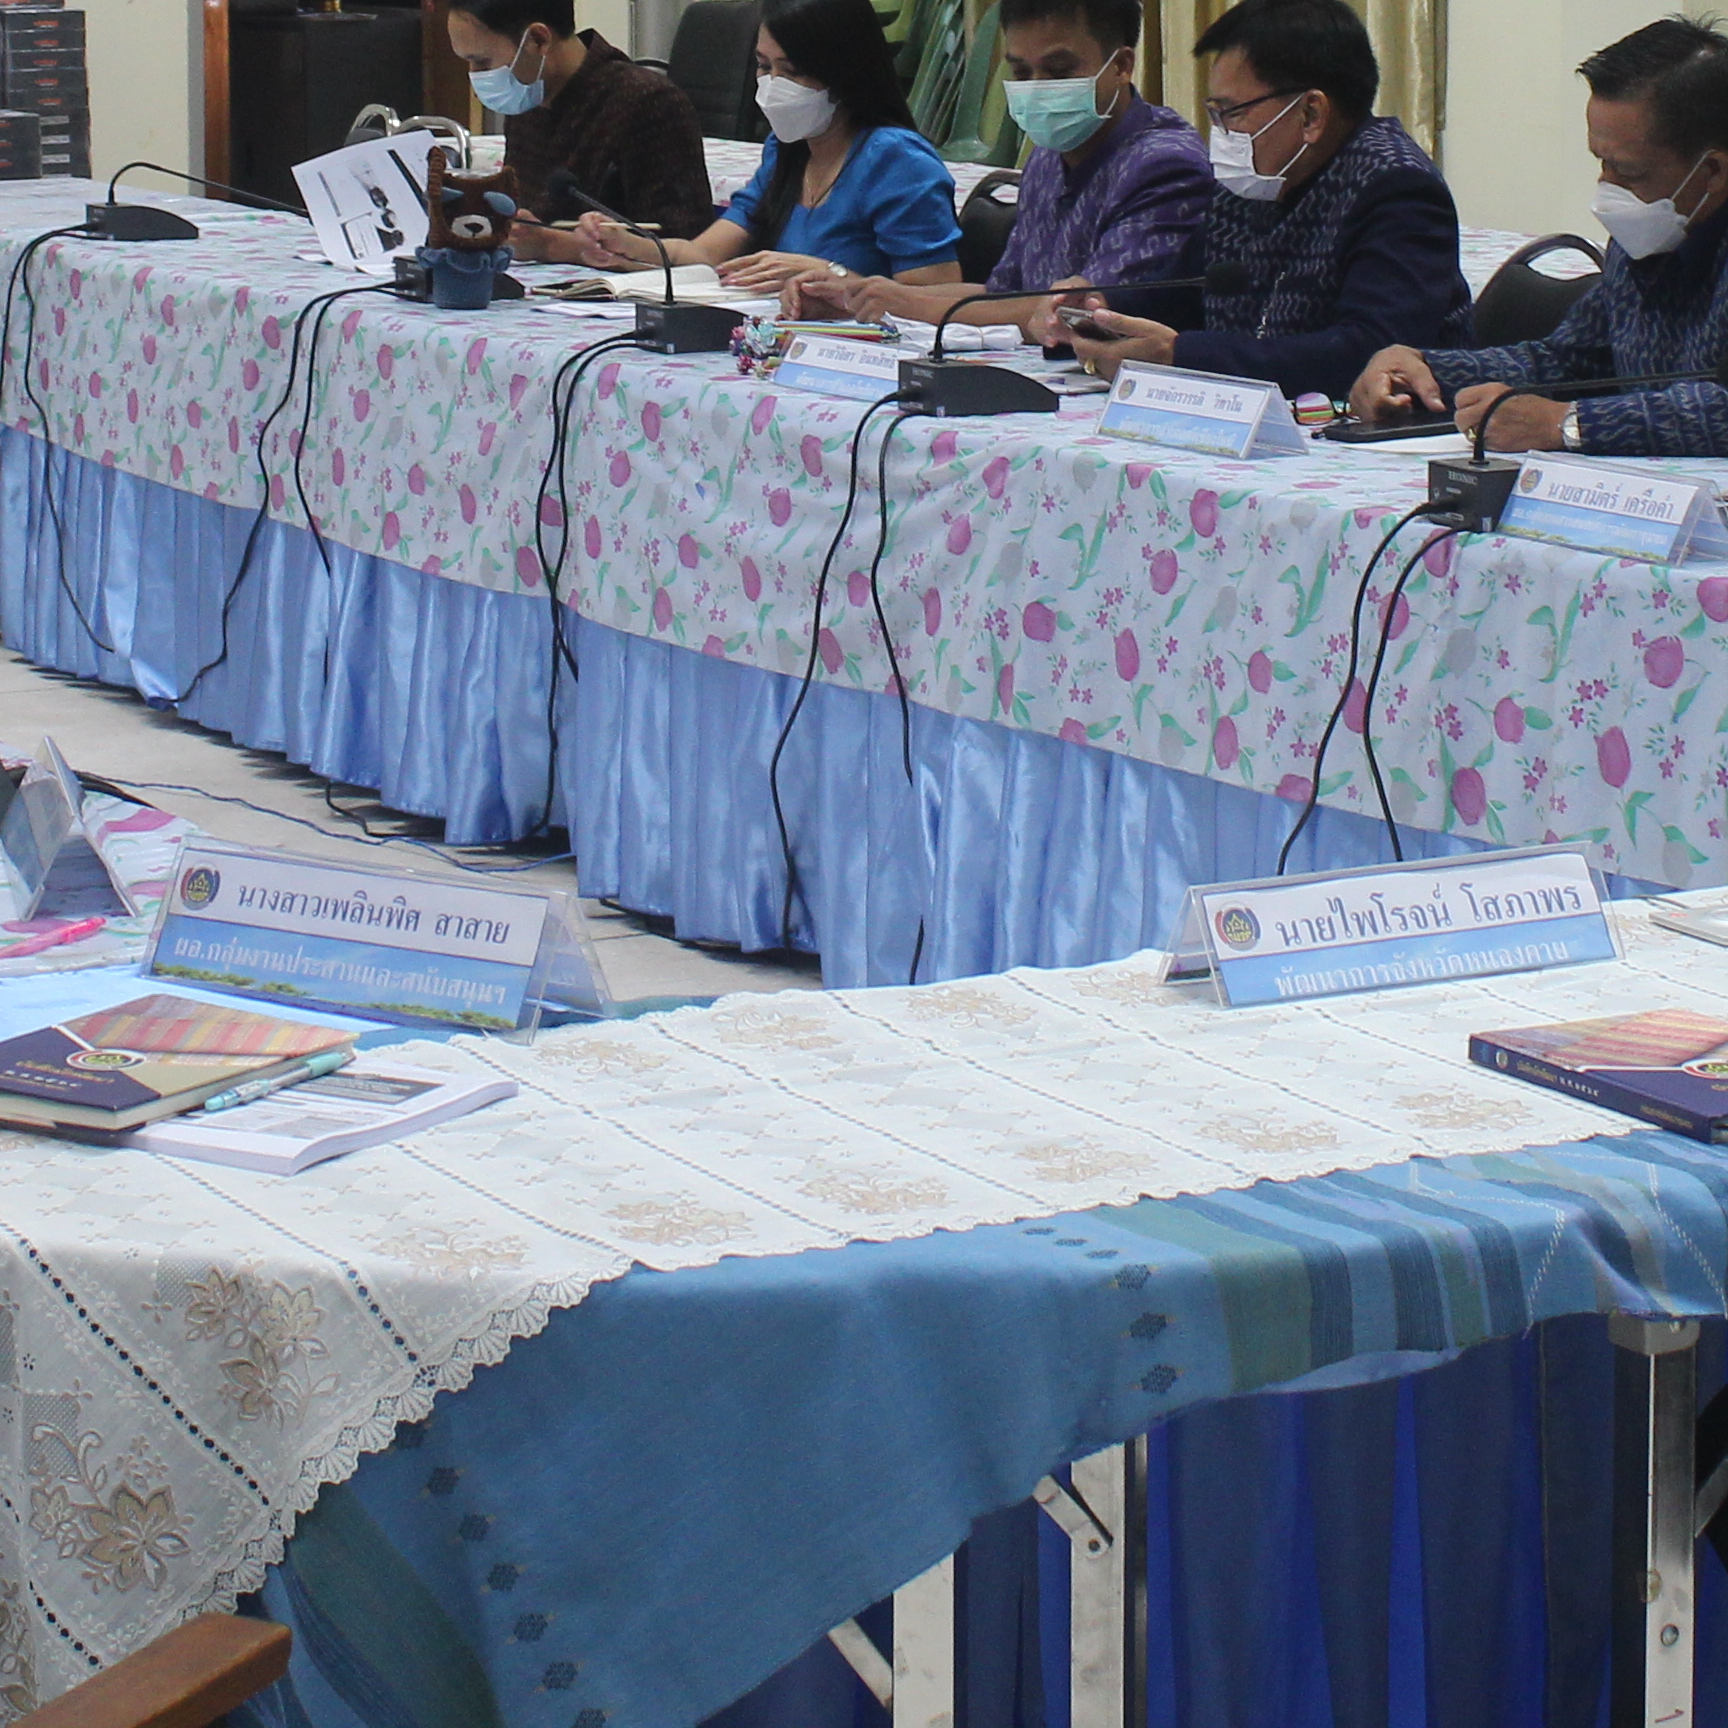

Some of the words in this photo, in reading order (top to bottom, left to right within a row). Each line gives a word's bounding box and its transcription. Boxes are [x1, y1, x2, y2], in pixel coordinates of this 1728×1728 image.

[238, 881, 421, 933] นางสาวเพลินพิศ
[434, 907, 511, 945] สาสาย
[1275, 883, 1452, 948] นายไพโรจน์
[1459, 882, 1583, 923] โสภาพร
[1275, 939, 1569, 997] พัฒนาการจังหวัดหนองคาย
